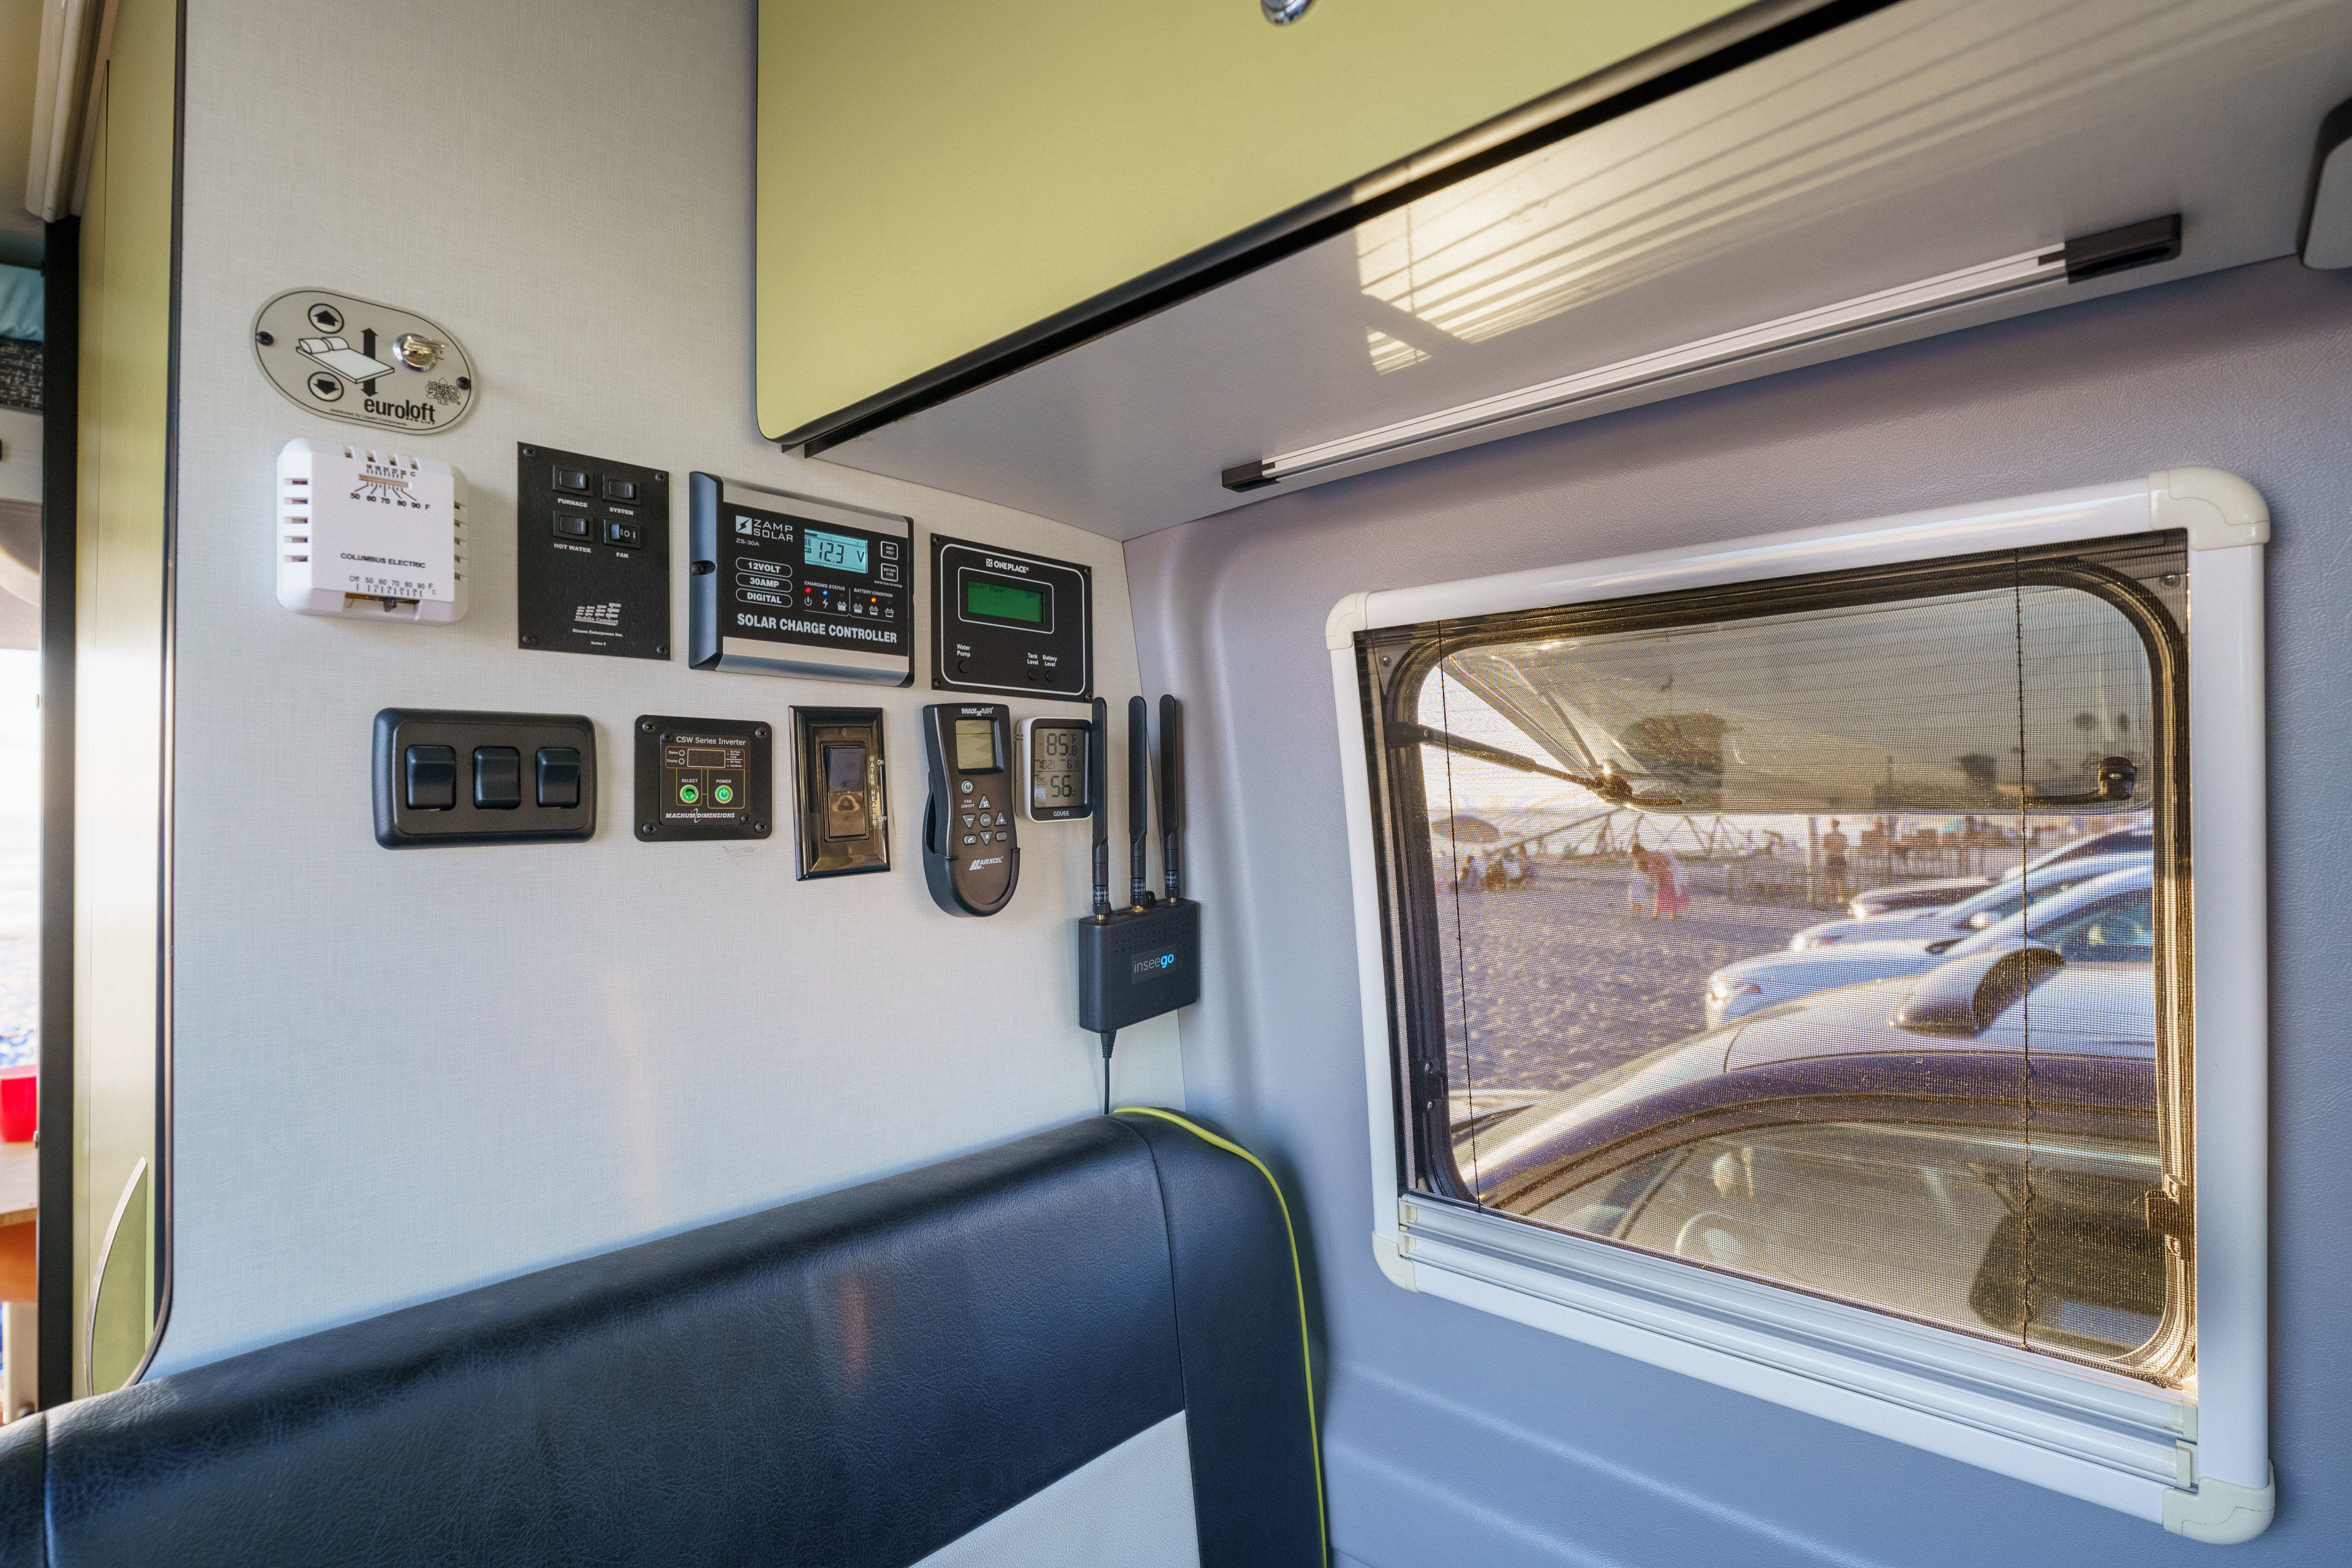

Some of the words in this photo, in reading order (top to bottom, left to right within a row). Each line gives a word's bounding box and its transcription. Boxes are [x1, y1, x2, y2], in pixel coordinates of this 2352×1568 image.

[427, 381, 459, 394] PROJECT
[364, 399, 435, 422] euroloft
[558, 498, 588, 508] FURNACE
[609, 507, 634, 516] SYSTEM
[754, 519, 793, 532] ZAMP
[754, 528, 793, 542] SOLAR
[736, 538, 760, 546] ZS-30A
[569, 545, 592, 553] WATER
[819, 541, 844, 564] 12.3
[857, 550, 865, 563] V
[340, 553, 386, 563] COLUMBUS
[388, 559, 426, 569] ELECTRIC
[748, 561, 781, 573] 12VOLT
[750, 577, 779, 588] 30AMP
[747, 592, 781, 604] DIGITAL
[737, 613, 776, 629] SOLAR
[780, 618, 826, 635] CHARGE
[828, 625, 897, 643] CONTROLLER
[1051, 775, 1072, 797] 56
[979, 857, 1002, 865] AIRXCEL
[1134, 954, 1174, 973] inseego
